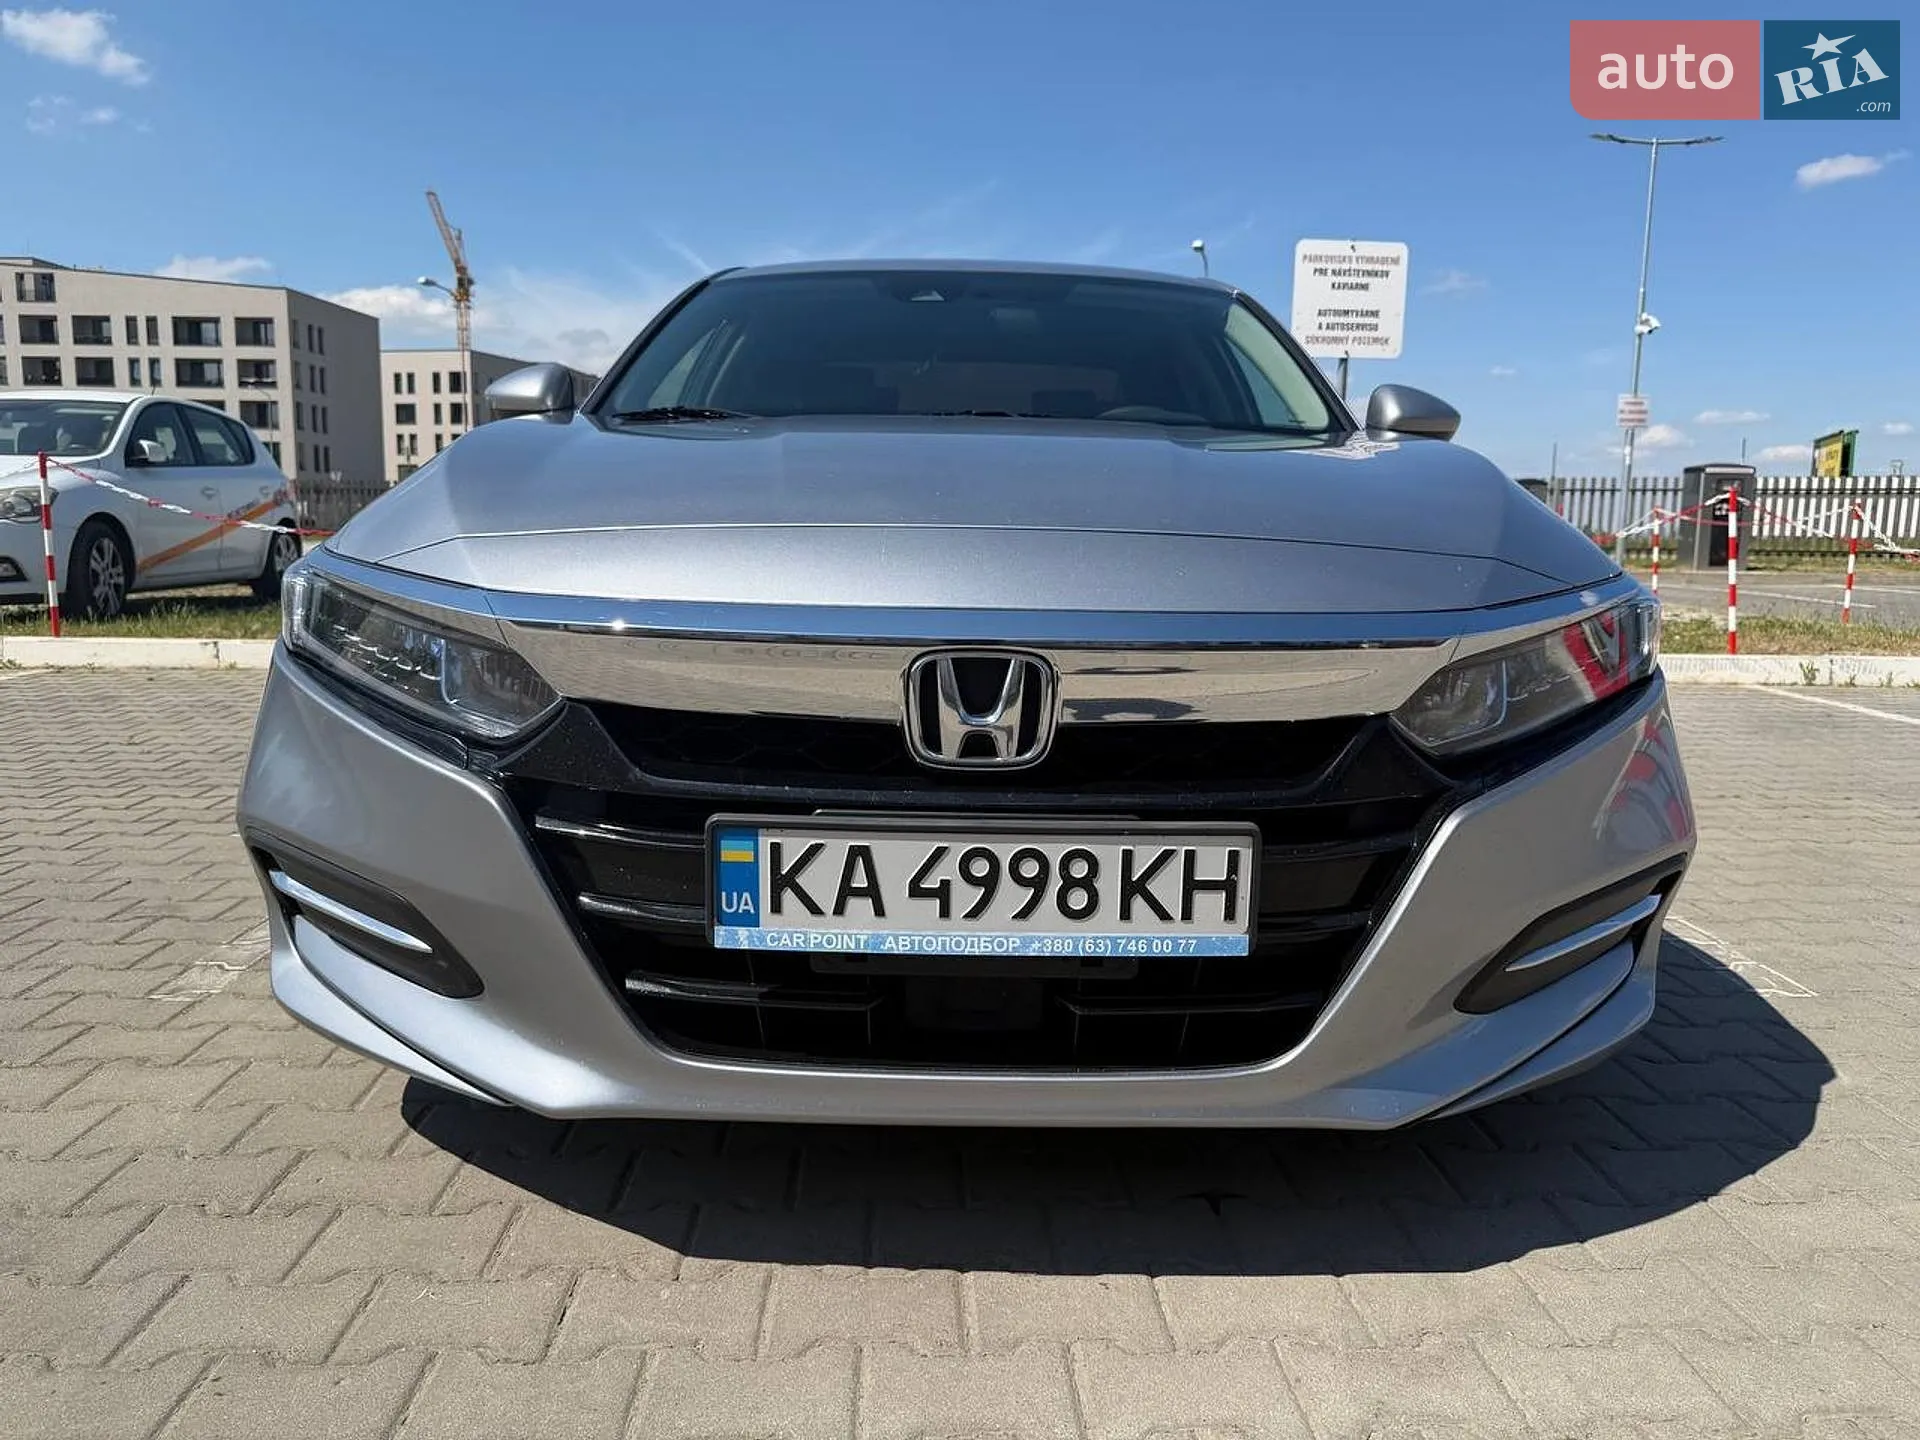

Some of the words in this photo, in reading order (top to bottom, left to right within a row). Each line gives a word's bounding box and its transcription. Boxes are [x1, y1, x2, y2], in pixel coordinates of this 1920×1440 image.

[1313, 267, 1328, 277] PRE
[1317, 322, 1323, 331] A
[1325, 322, 1378, 332] AUTOSERVISU
[768, 840, 887, 917] KA
[907, 844, 1100, 921] 4998
[1118, 847, 1241, 922] KH
[721, 891, 755, 914] UA
[766, 932, 806, 948] CAR
[809, 933, 868, 949] POINT
[884, 934, 1021, 954] АВТОПОДБОР
[1030, 938, 1074, 953] +380
[1077, 938, 1112, 955] (63)
[1116, 938, 1148, 954] 746
[1152, 939, 1173, 953] 00
[1177, 938, 1198, 954] 77
